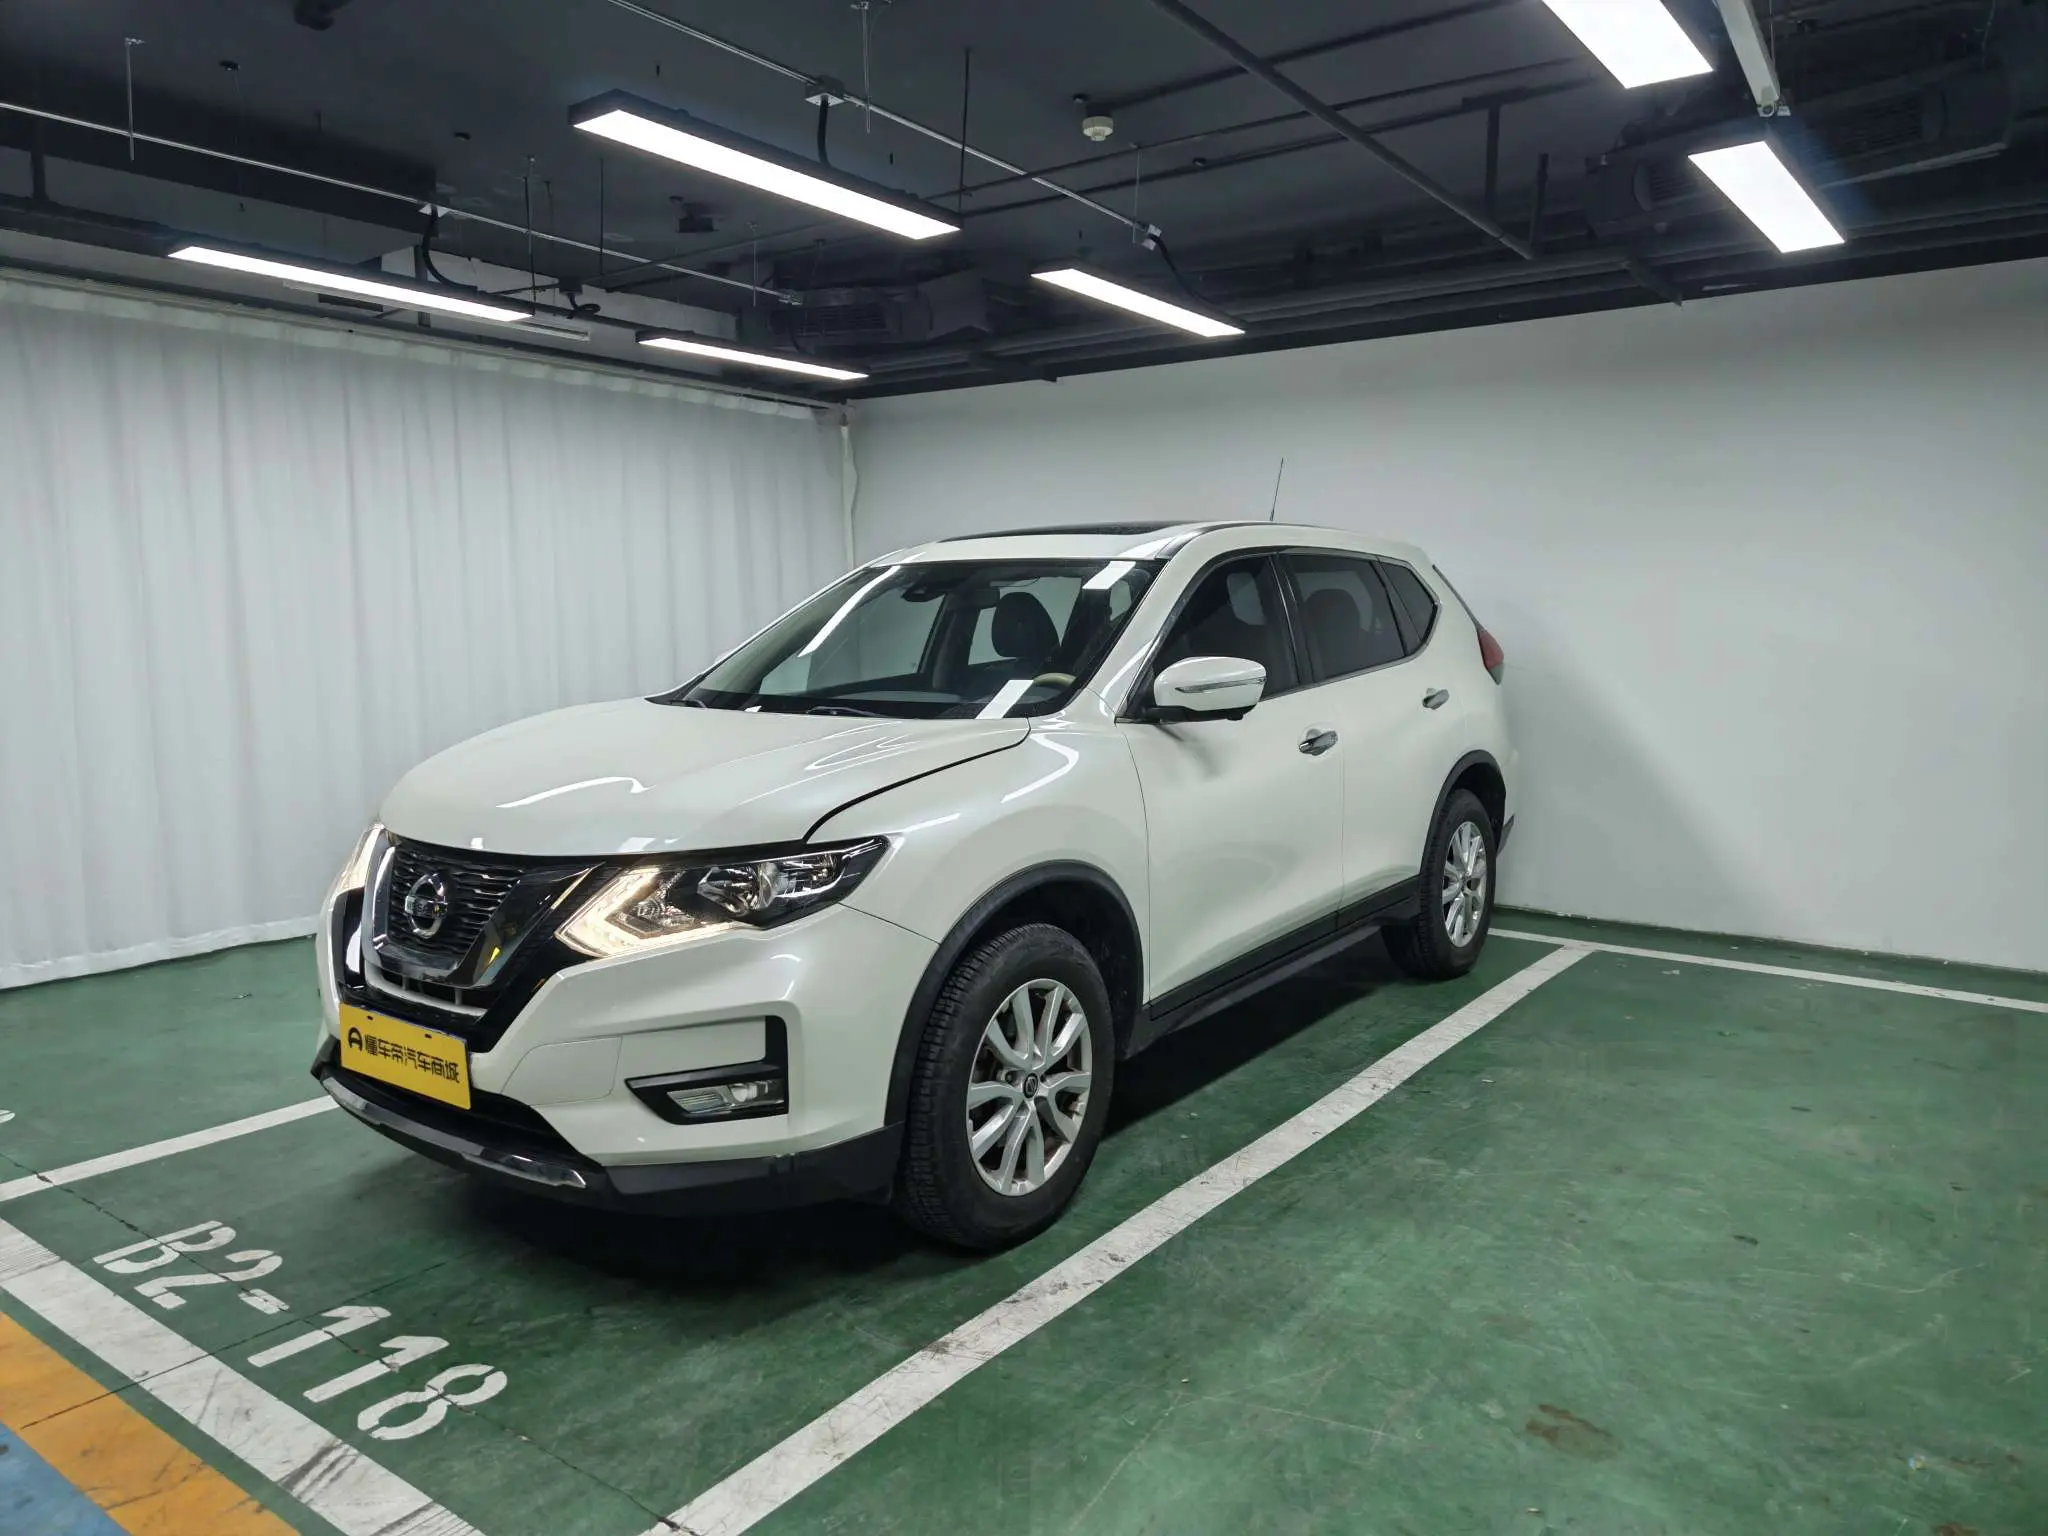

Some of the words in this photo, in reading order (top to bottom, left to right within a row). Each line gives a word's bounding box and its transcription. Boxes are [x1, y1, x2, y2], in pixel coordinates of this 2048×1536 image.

[365, 1035, 460, 1083] 懂车帝汽车商城
[93, 1220, 508, 1440] B2-118
